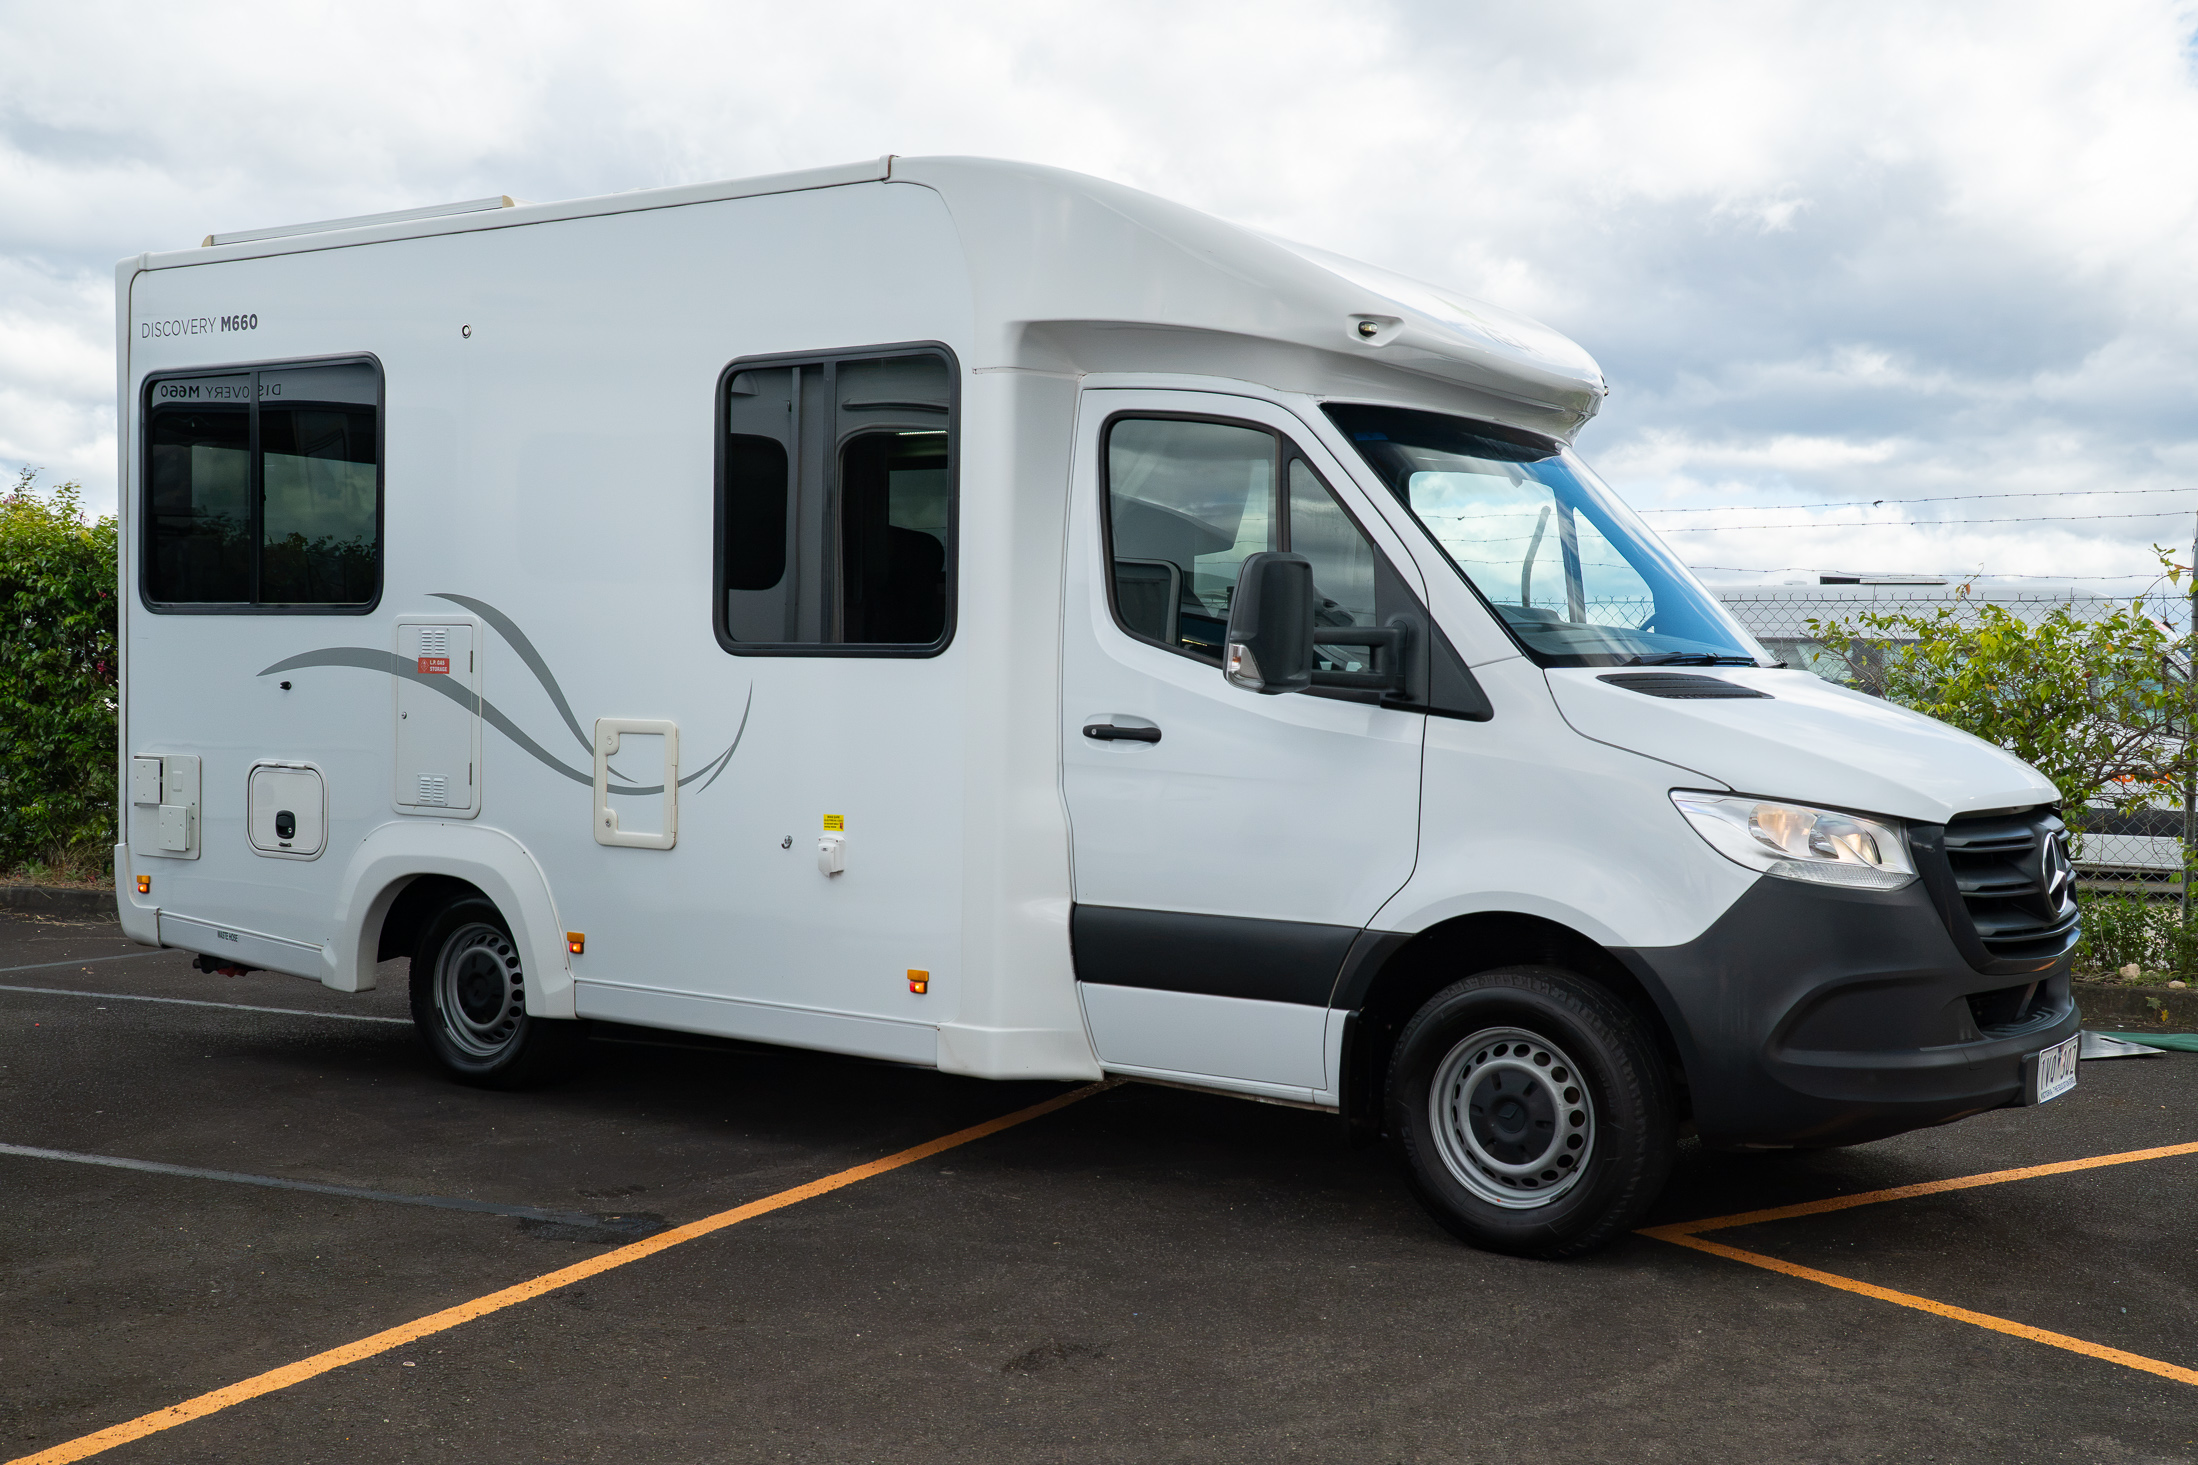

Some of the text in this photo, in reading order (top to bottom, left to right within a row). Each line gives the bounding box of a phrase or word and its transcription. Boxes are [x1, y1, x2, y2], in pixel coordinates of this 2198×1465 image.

[141, 313, 258, 339] DISCOVERY M660
[228, 932, 239, 943] HOSE
